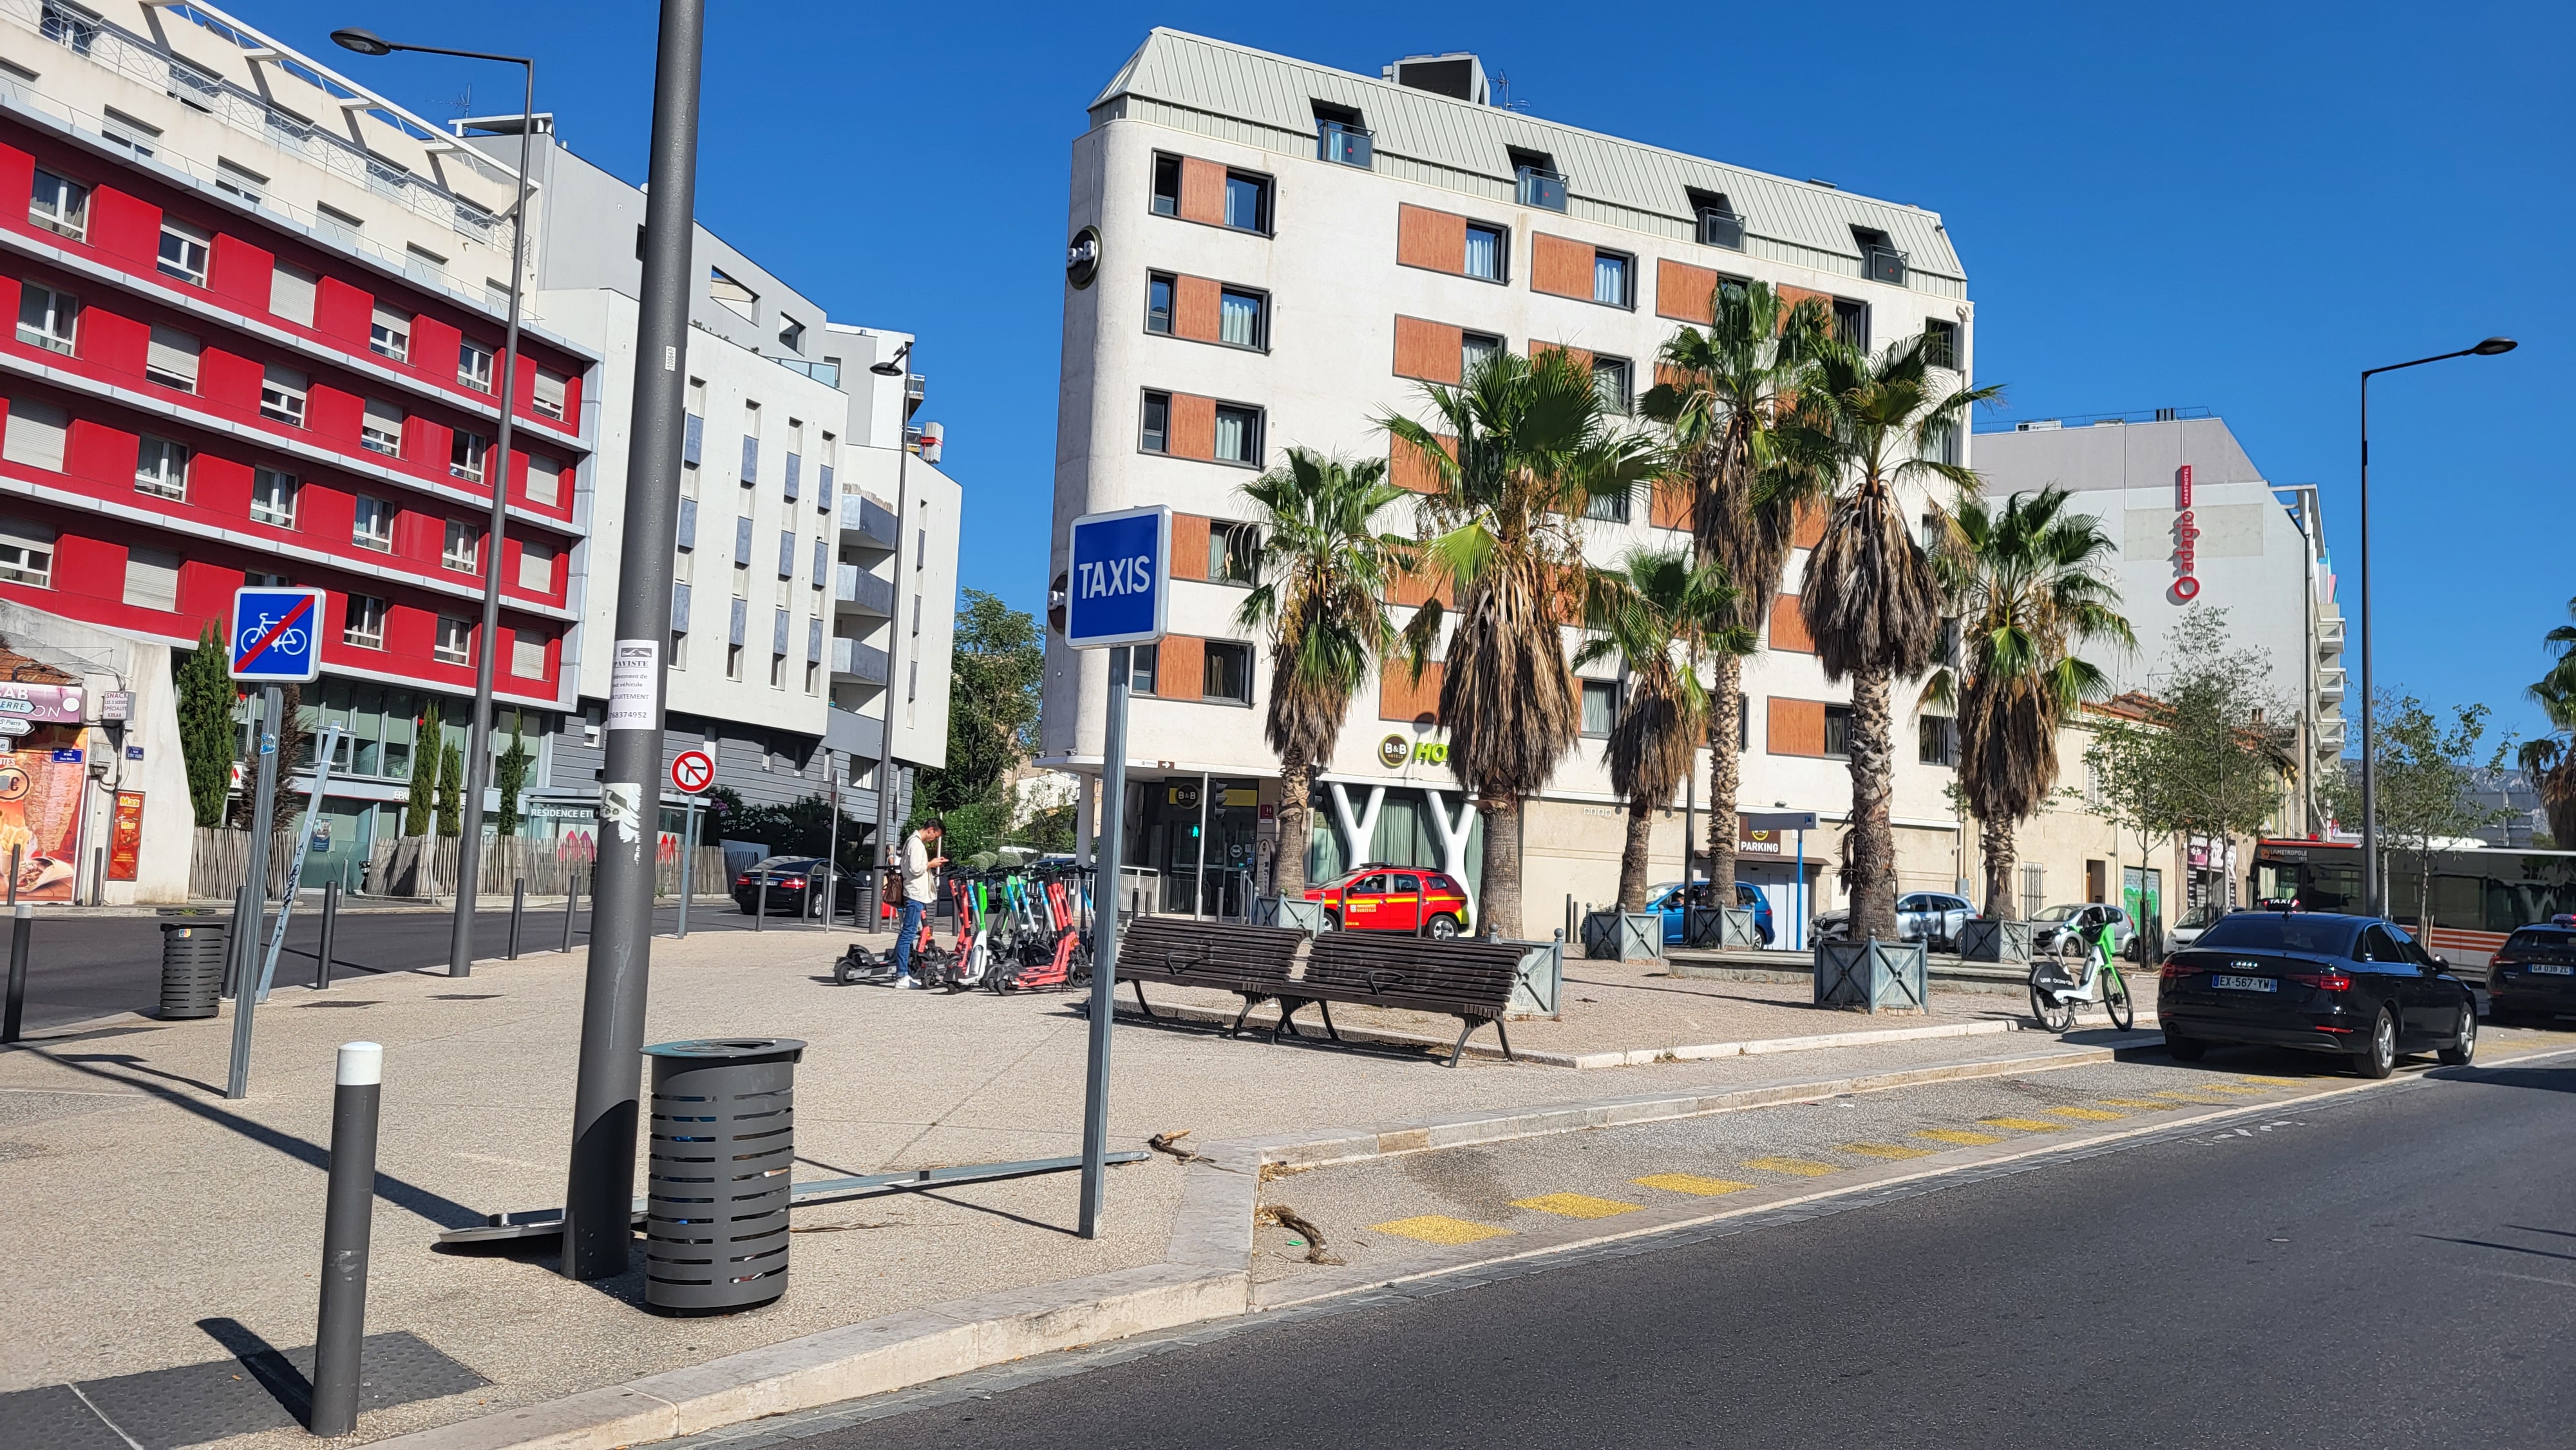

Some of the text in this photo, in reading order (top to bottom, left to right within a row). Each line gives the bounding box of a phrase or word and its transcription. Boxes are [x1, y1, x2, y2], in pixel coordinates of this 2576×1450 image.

[2175, 511, 2201, 572] adagio
[1079, 555, 1150, 599] TAXIS
[1385, 742, 1406, 755] B&B
[1415, 742, 1449, 762] HO
[120, 796, 140, 807] Max
[1178, 791, 1197, 800] B&B
[531, 809, 578, 818] RESIDENCE
[1741, 842, 1779, 852] PARKING
[2219, 977, 2269, 989] EX-567-YW
